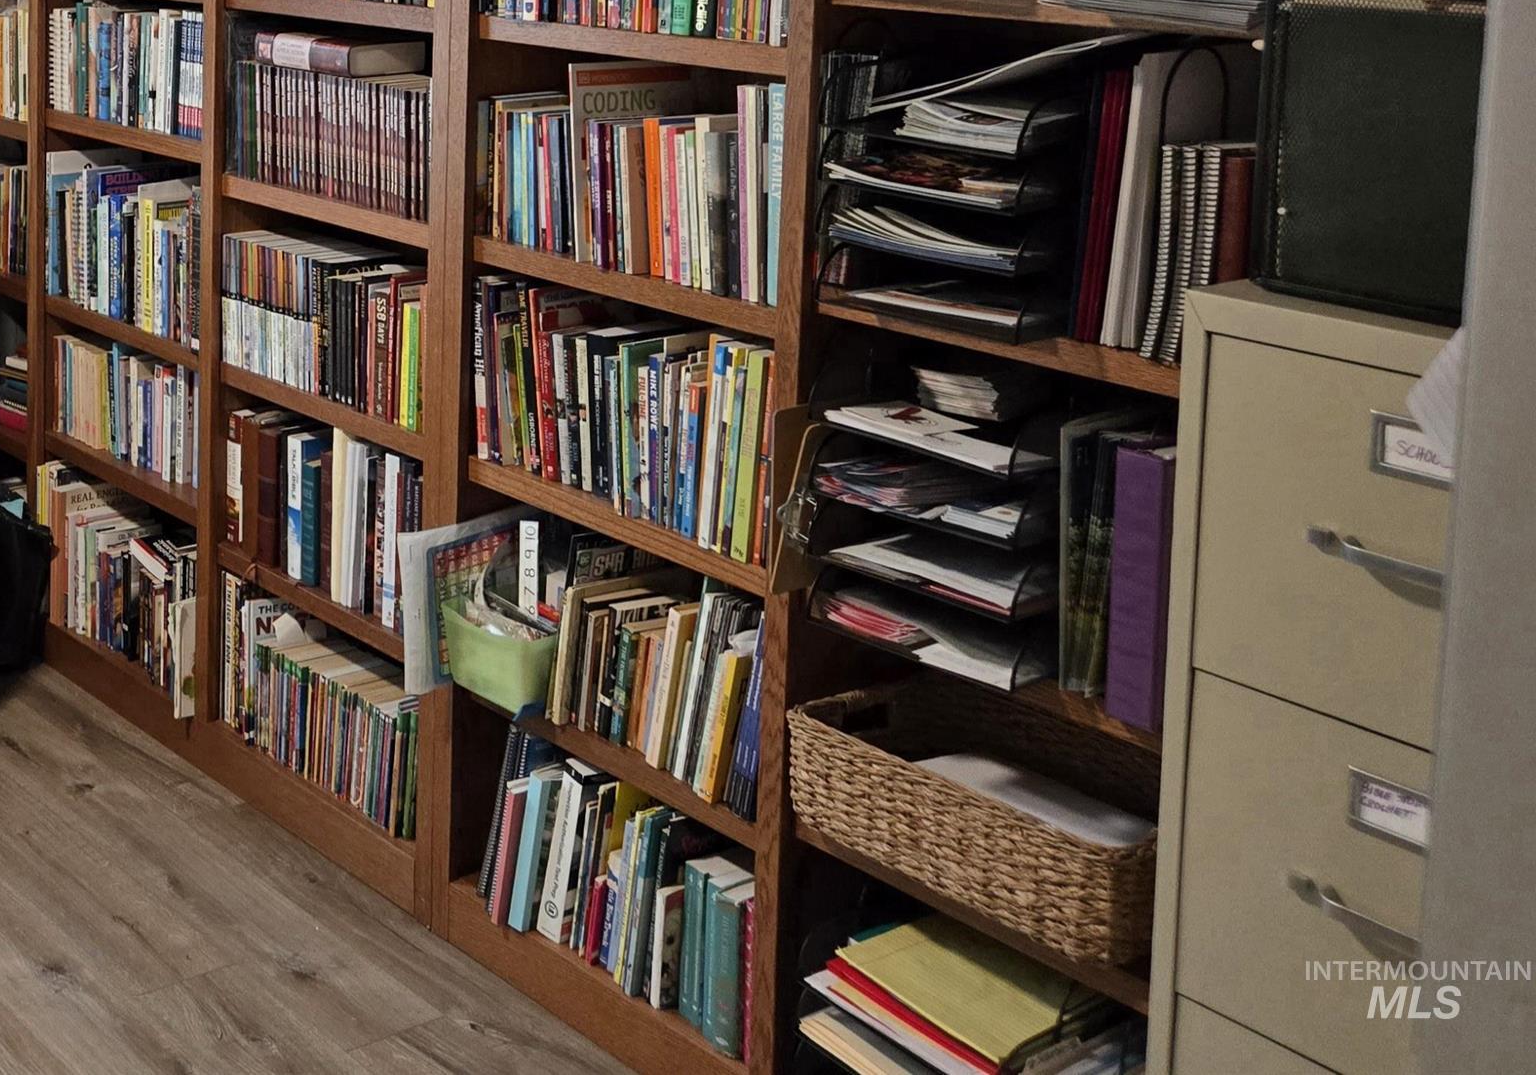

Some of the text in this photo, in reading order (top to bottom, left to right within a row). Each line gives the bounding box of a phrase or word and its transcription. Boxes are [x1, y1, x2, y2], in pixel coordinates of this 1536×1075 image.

[582, 89, 656, 114] CODING
[771, 92, 783, 199] LARGE FAMILY
[376, 322, 385, 344] DAYS
[474, 300, 483, 356] American
[519, 311, 528, 348] TRAVELER
[638, 377, 646, 419] FULL-TIME
[650, 370, 658, 431] MIKE ROWE
[528, 412, 536, 447] USBORNE
[71, 491, 94, 505] REAL
[525, 525, 536, 541] 10
[524, 549, 534, 559] 9
[524, 568, 535, 578] 8
[524, 586, 535, 597] 7
[258, 604, 279, 614] THE
[551, 782, 574, 899] Inspection Authorization Test Prep
